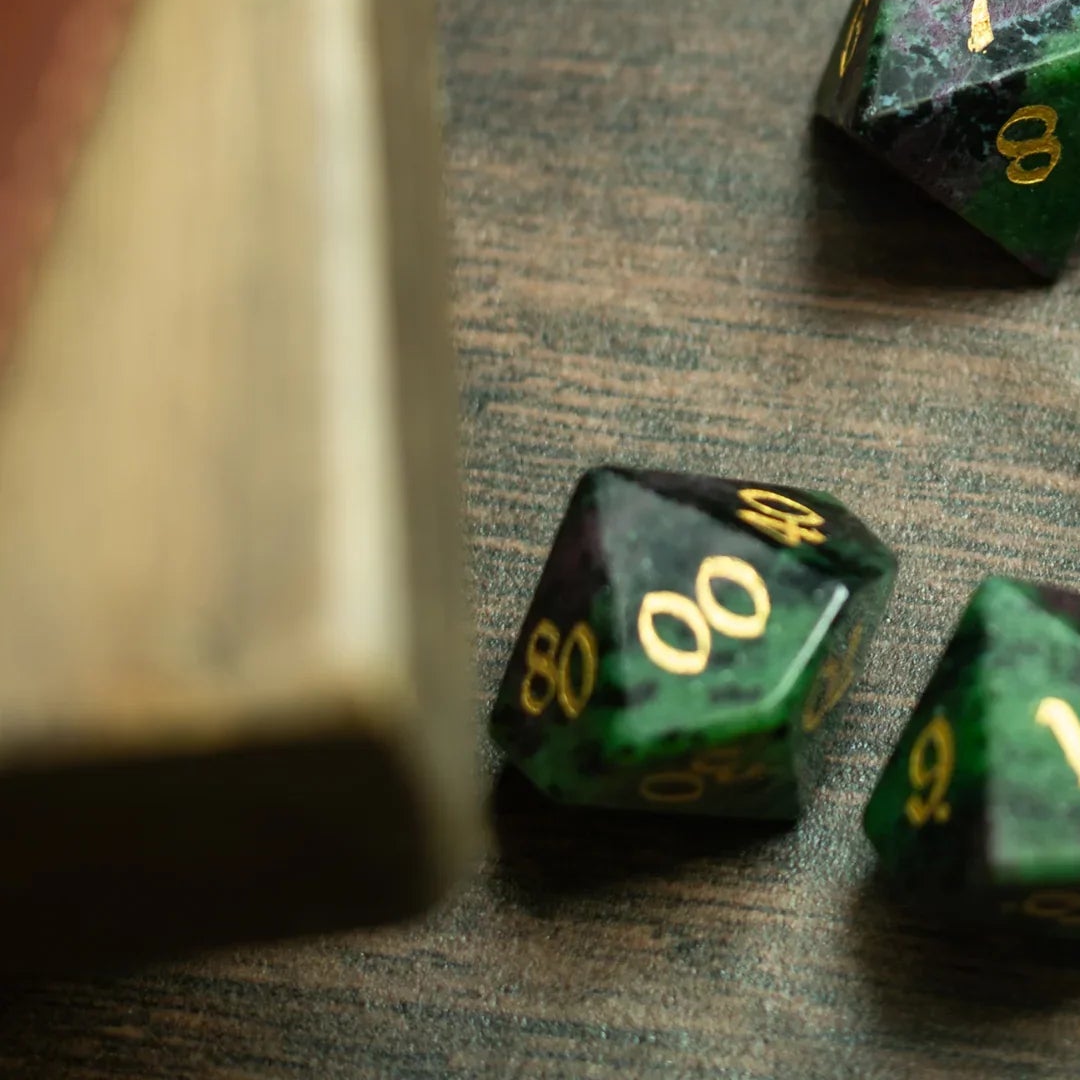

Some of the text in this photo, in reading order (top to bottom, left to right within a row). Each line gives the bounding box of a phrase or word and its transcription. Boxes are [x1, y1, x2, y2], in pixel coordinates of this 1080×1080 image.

[996, 104, 1062, 185] 8
[638, 554, 771, 675] 00
[519, 617, 599, 718] 80
